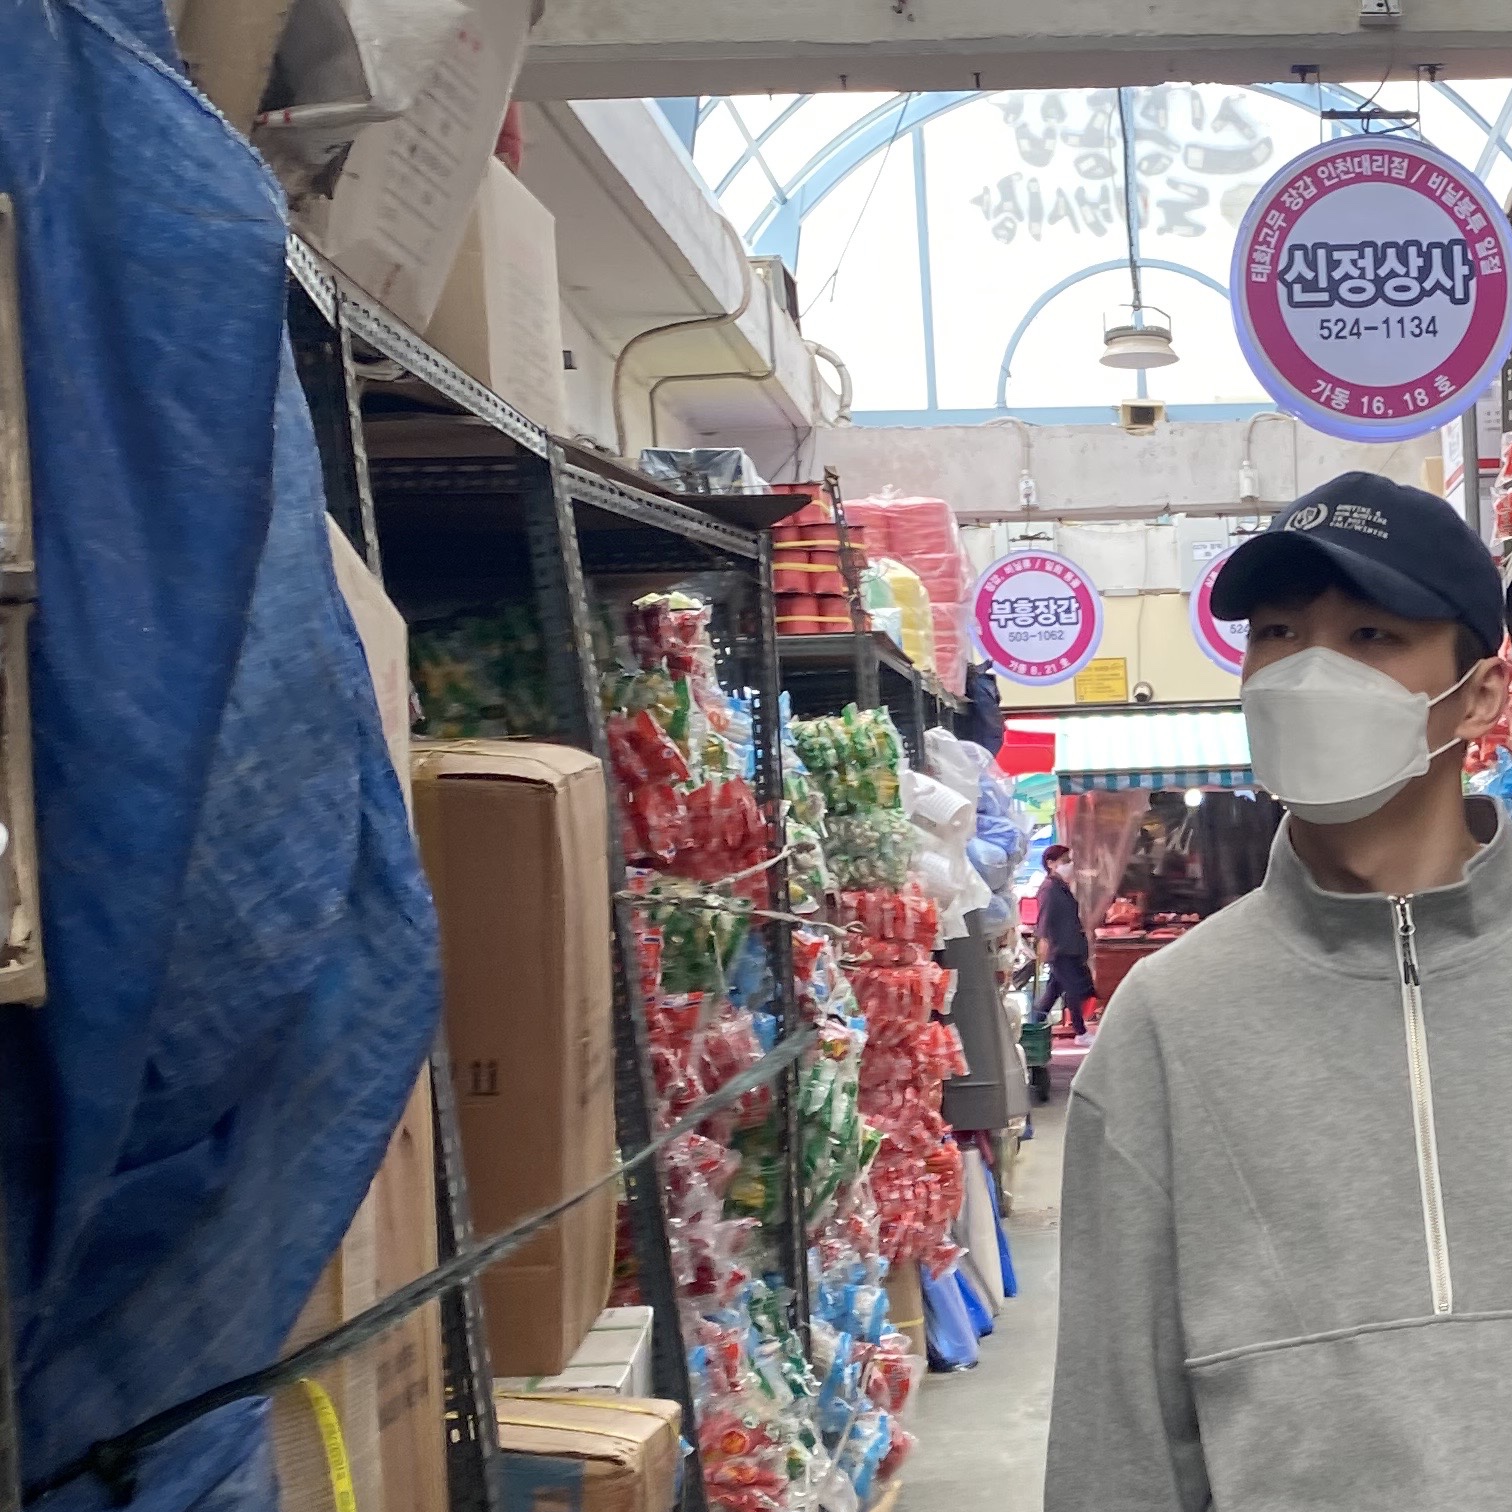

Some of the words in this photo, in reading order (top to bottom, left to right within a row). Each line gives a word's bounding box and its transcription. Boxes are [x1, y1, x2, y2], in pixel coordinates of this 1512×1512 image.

[1250, 209, 1287, 283] 태화고무
[1280, 175, 1318, 211] 장갑
[1316, 154, 1409, 187] 인천대리점
[1427, 172, 1488, 234] 비닐봉투
[1280, 241, 1474, 306] 신정상사
[1319, 315, 1439, 340] 524-1134
[1311, 379, 1351, 410] 가동
[1360, 395, 1394, 417] 16,
[1403, 388, 1430, 411] 18
[1433, 374, 1457, 398] 호
[990, 597, 1080, 628] 부흥장갑
[1008, 630, 1065, 642] 503-1062
